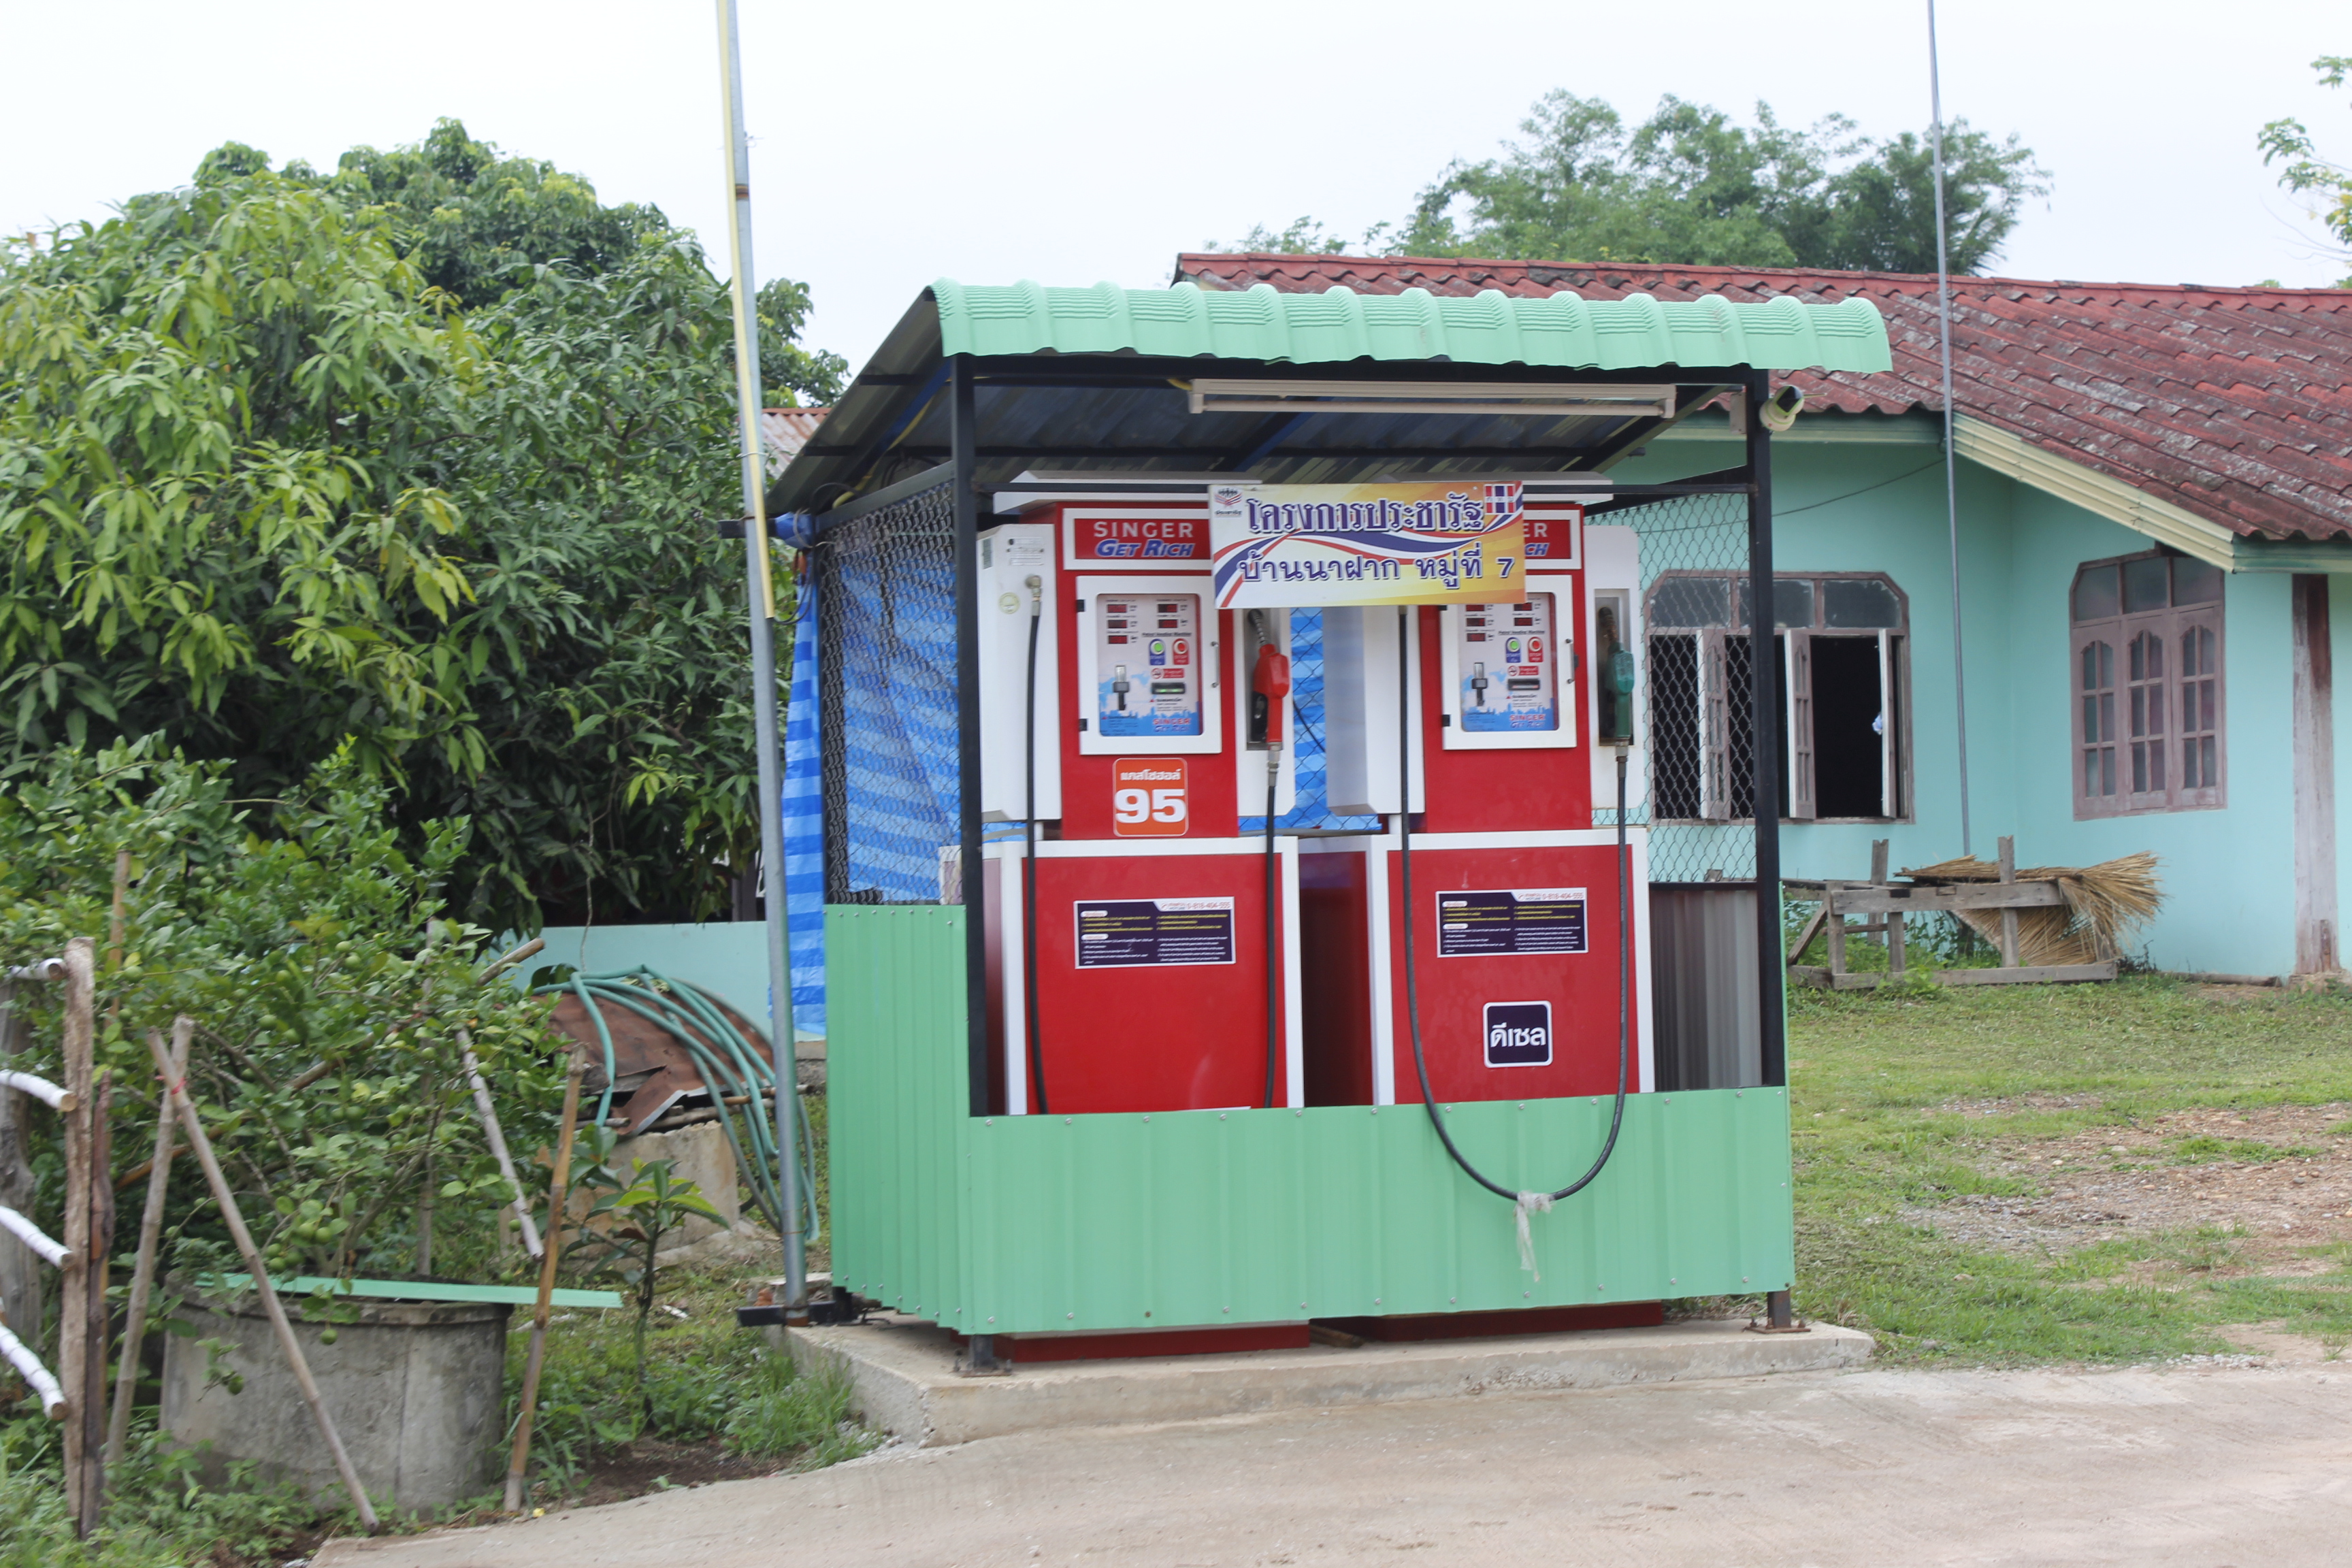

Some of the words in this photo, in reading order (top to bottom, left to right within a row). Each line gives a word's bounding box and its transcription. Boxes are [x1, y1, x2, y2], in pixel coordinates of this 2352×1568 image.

[1094, 521, 1193, 538] SINGER
[1246, 492, 1484, 533] โครงการประชารัฐ
[1239, 550, 1400, 582] บ้านนาฝาก
[1415, 542, 1482, 589] หมู่ที่
[1496, 557, 1515, 578] 7
[1115, 788, 1186, 823] 95
[1490, 1022, 1546, 1047] ดีเซล
